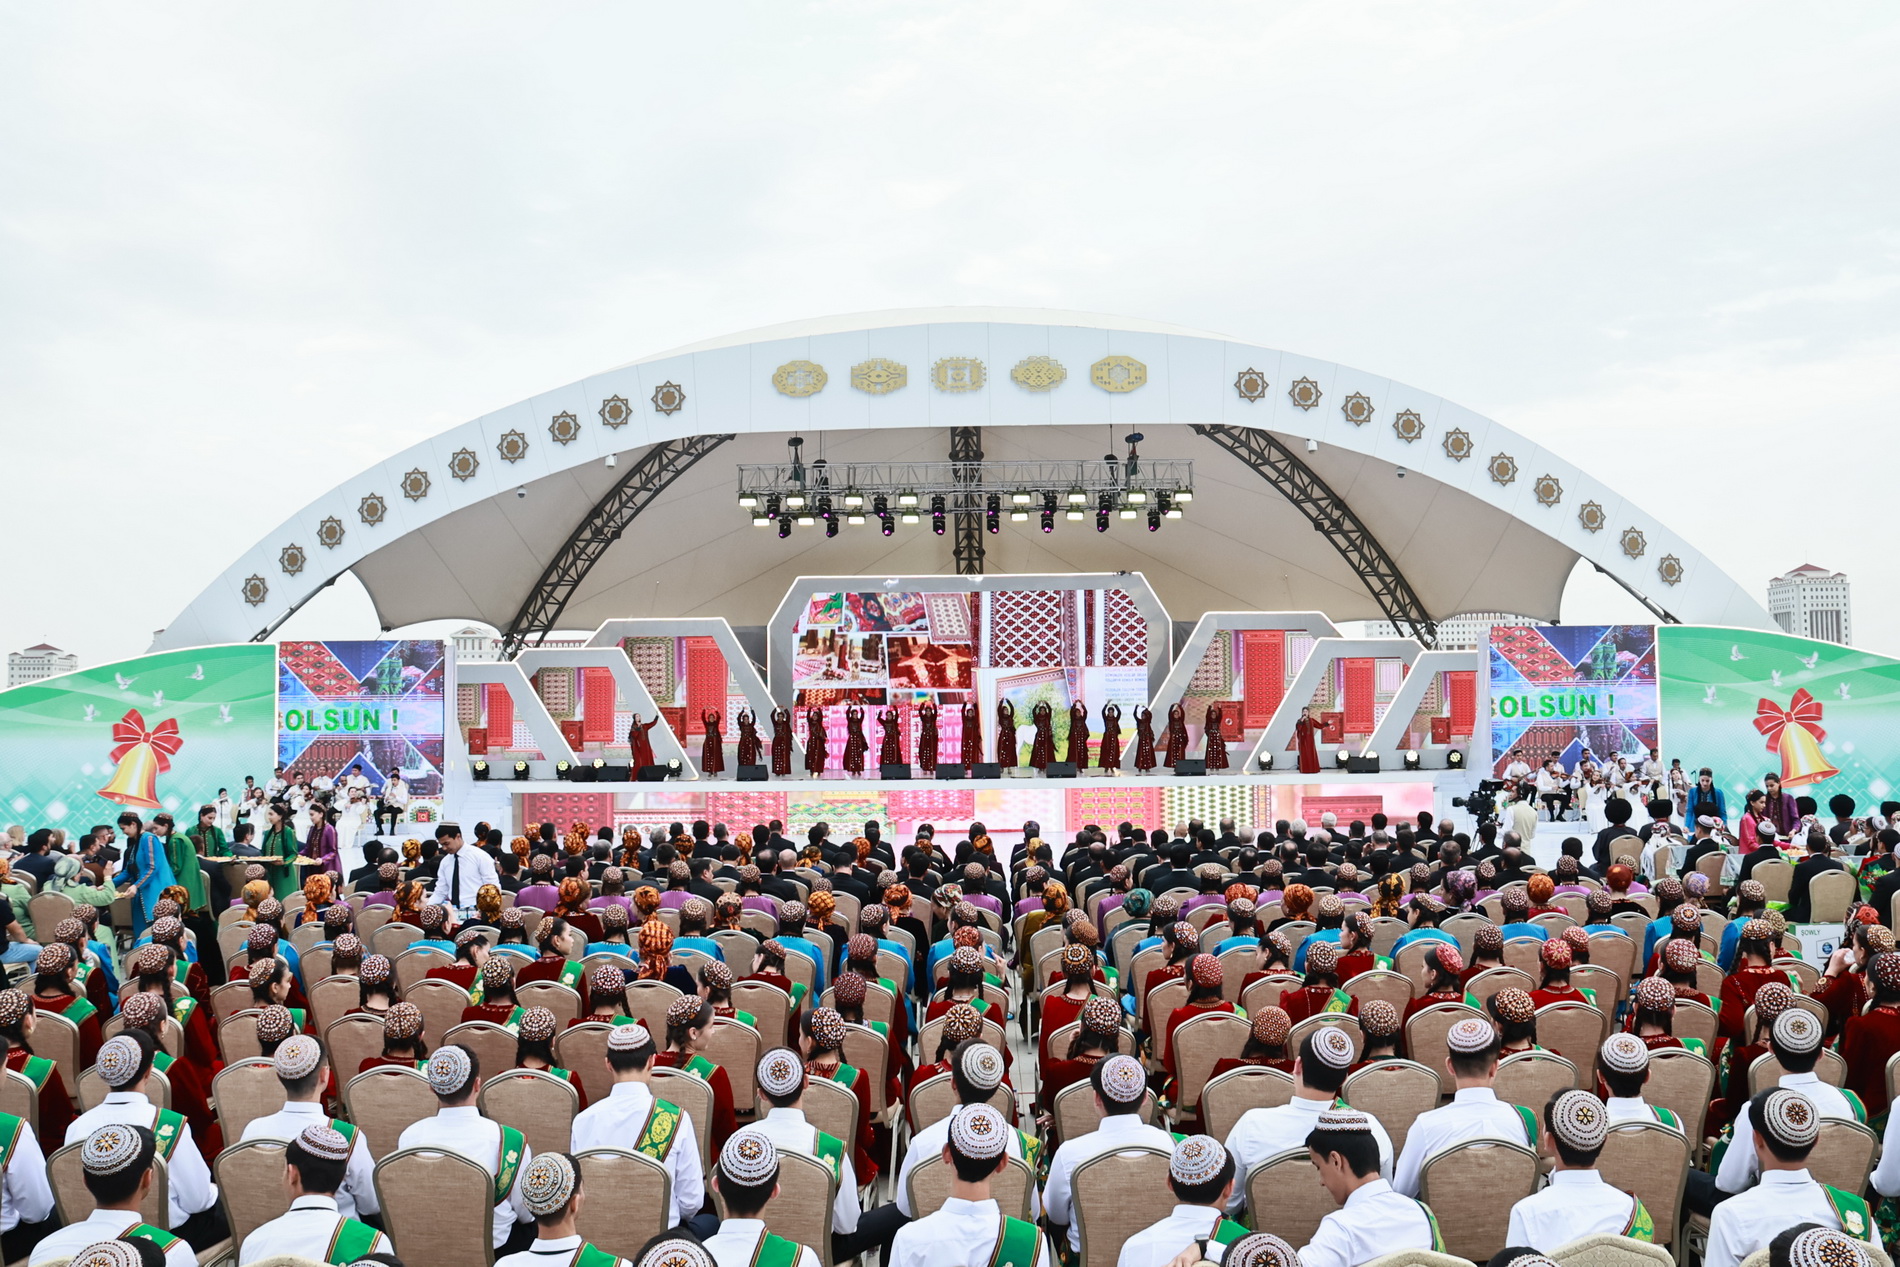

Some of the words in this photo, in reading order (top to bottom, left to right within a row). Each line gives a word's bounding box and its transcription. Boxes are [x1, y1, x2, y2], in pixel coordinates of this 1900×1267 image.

[1608, 694, 1614, 715] !
[278, 709, 380, 731] OLSUN
[392, 709, 398, 730] !
